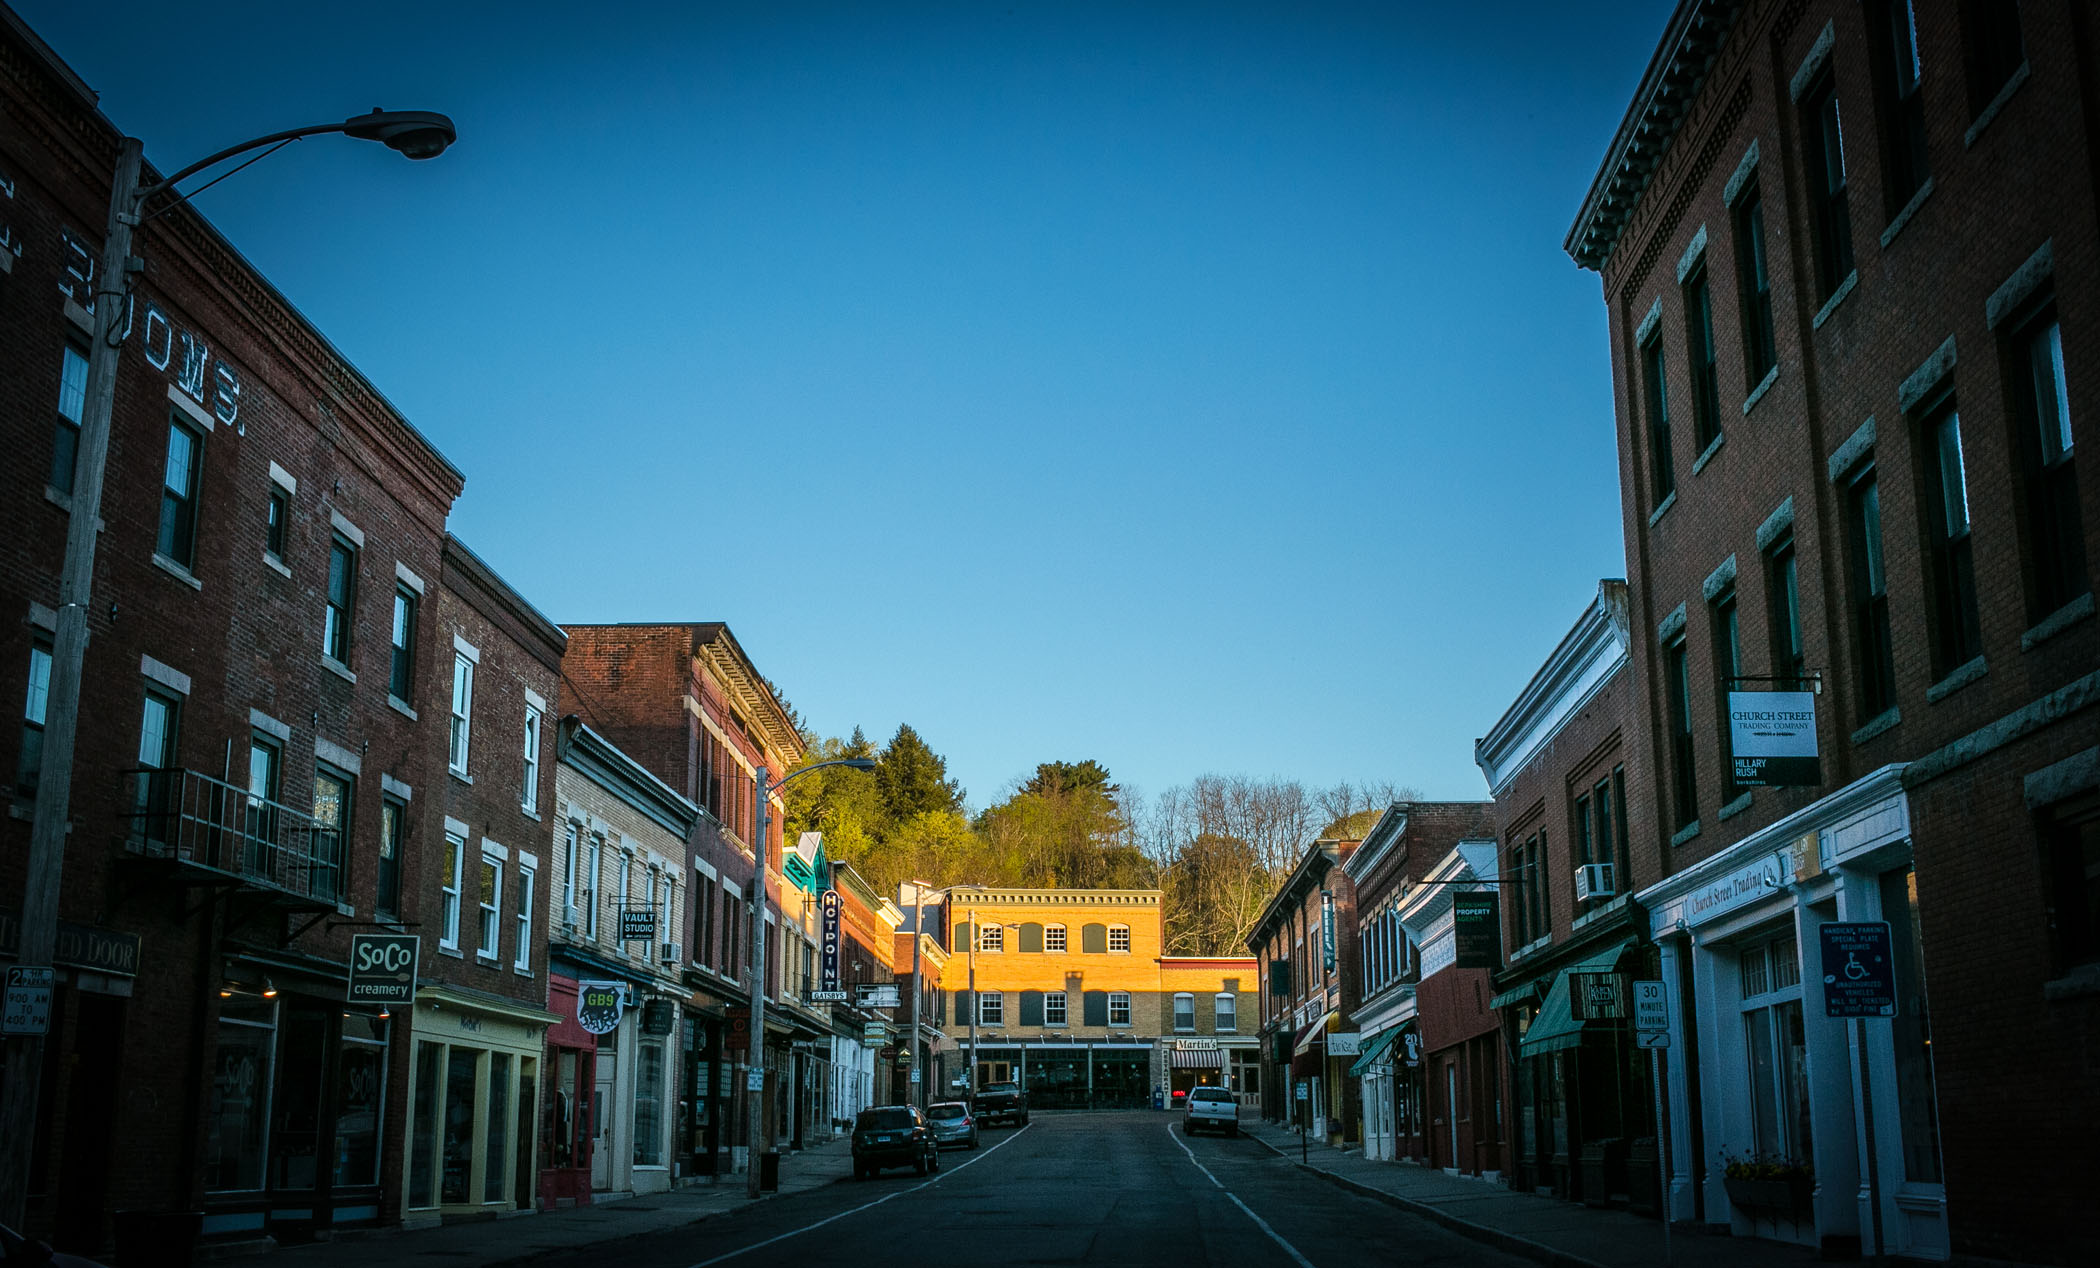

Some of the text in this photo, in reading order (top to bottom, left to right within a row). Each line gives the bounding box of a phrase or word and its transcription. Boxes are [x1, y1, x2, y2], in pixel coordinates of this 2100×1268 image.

[1732, 711, 1813, 720] CHURCH STREET
[1773, 722, 1809, 730] COMPANY
[1735, 759, 1767, 768] HILLARY
[1735, 768, 1758, 777] RUSH
[1692, 888, 1713, 915] Church
[1713, 884, 1733, 906] Street
[1733, 871, 1762, 895] Trading
[624, 913, 655, 922] VAULT
[624, 923, 654, 933] STUDIO
[88, 932, 133, 969] DOOR
[357, 942, 412, 972] SoCo
[11, 969, 21, 986] 2
[354, 983, 408, 998] creamery
[1643, 986, 1657, 998] 30
[35, 994, 48, 1003] AM
[588, 993, 614, 1007] GB9
[22, 1004, 33, 1015] TO
[1640, 1001, 1663, 1011] MINUTE
[32, 1015, 46, 1025] PM
[1640, 1016, 1665, 1026] PARKING
[1178, 1039, 1217, 1049] Martin's
[1404, 1033, 1418, 1045] 20
